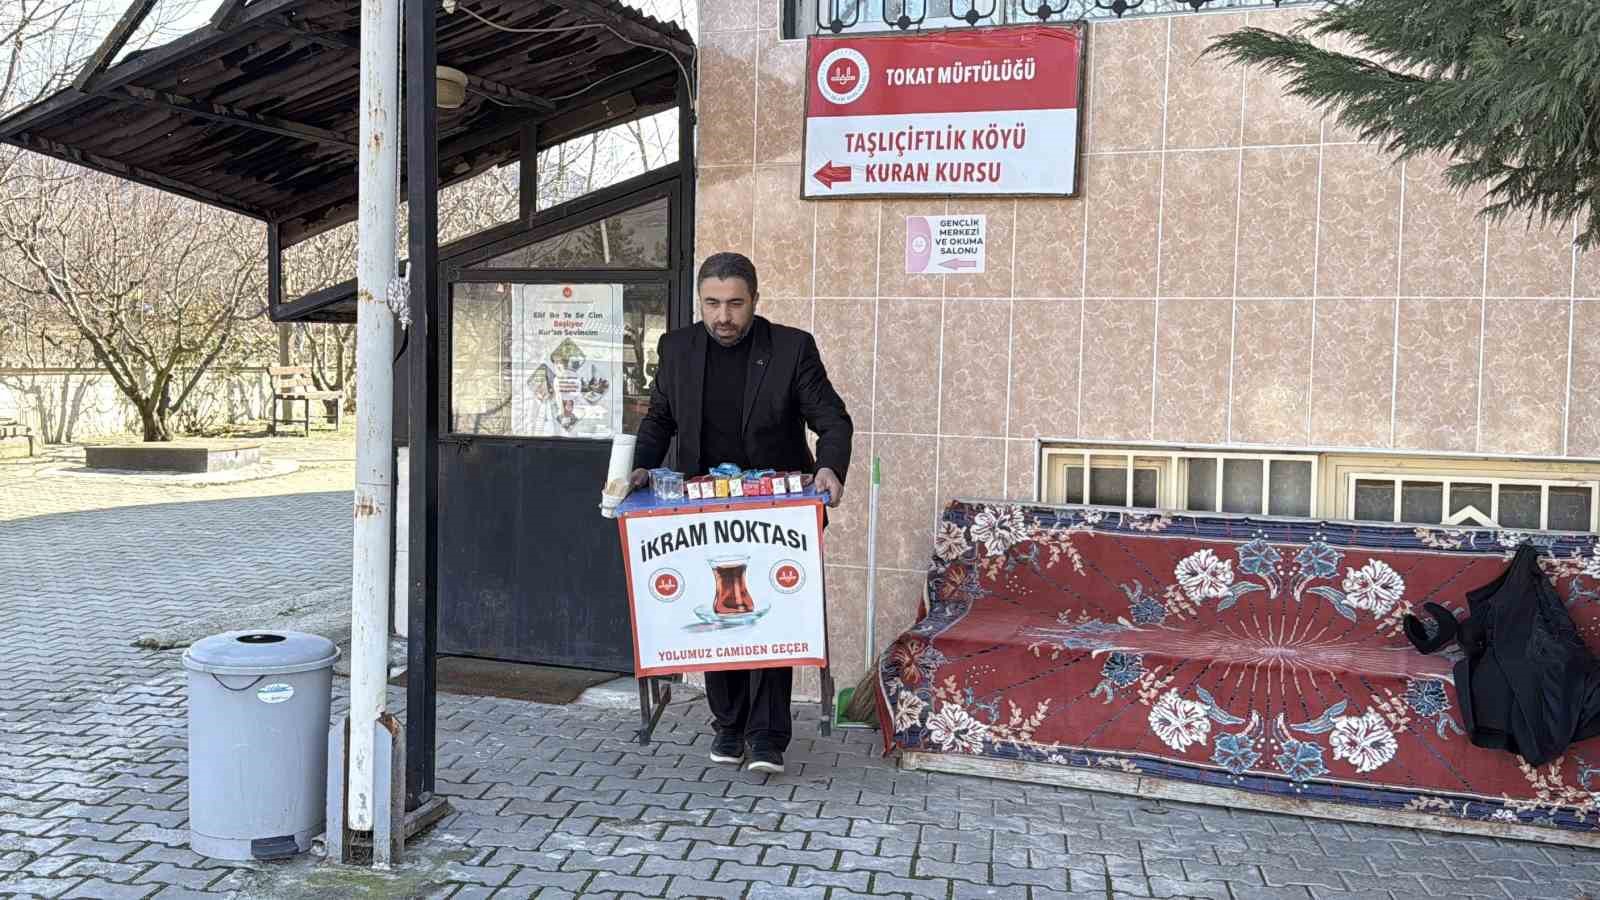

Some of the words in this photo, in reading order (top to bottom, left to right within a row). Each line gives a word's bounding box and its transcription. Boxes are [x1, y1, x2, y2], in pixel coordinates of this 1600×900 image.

[886, 66, 934, 86] TOKAT
[937, 57, 1036, 84] MÜFTÜLÜĞÜ
[845, 124, 966, 158] TAŞLIÇİFTLİK
[972, 122, 1026, 150] KÖYÜ
[865, 162, 929, 183] KURAN
[935, 161, 1001, 183] KURSU
[939, 228, 980, 236] MERKEZİ
[940, 218, 980, 229] GENÇLİK
[949, 237, 984, 245] OKUMA
[940, 247, 978, 255] SALONU
[640, 522, 708, 562] İKRAM
[714, 519, 808, 552] NOKTASI
[658, 648, 712, 661] YOLUMUZ
[716, 643, 768, 657] CAMİDEN
[771, 642, 809, 656] GEÇER
